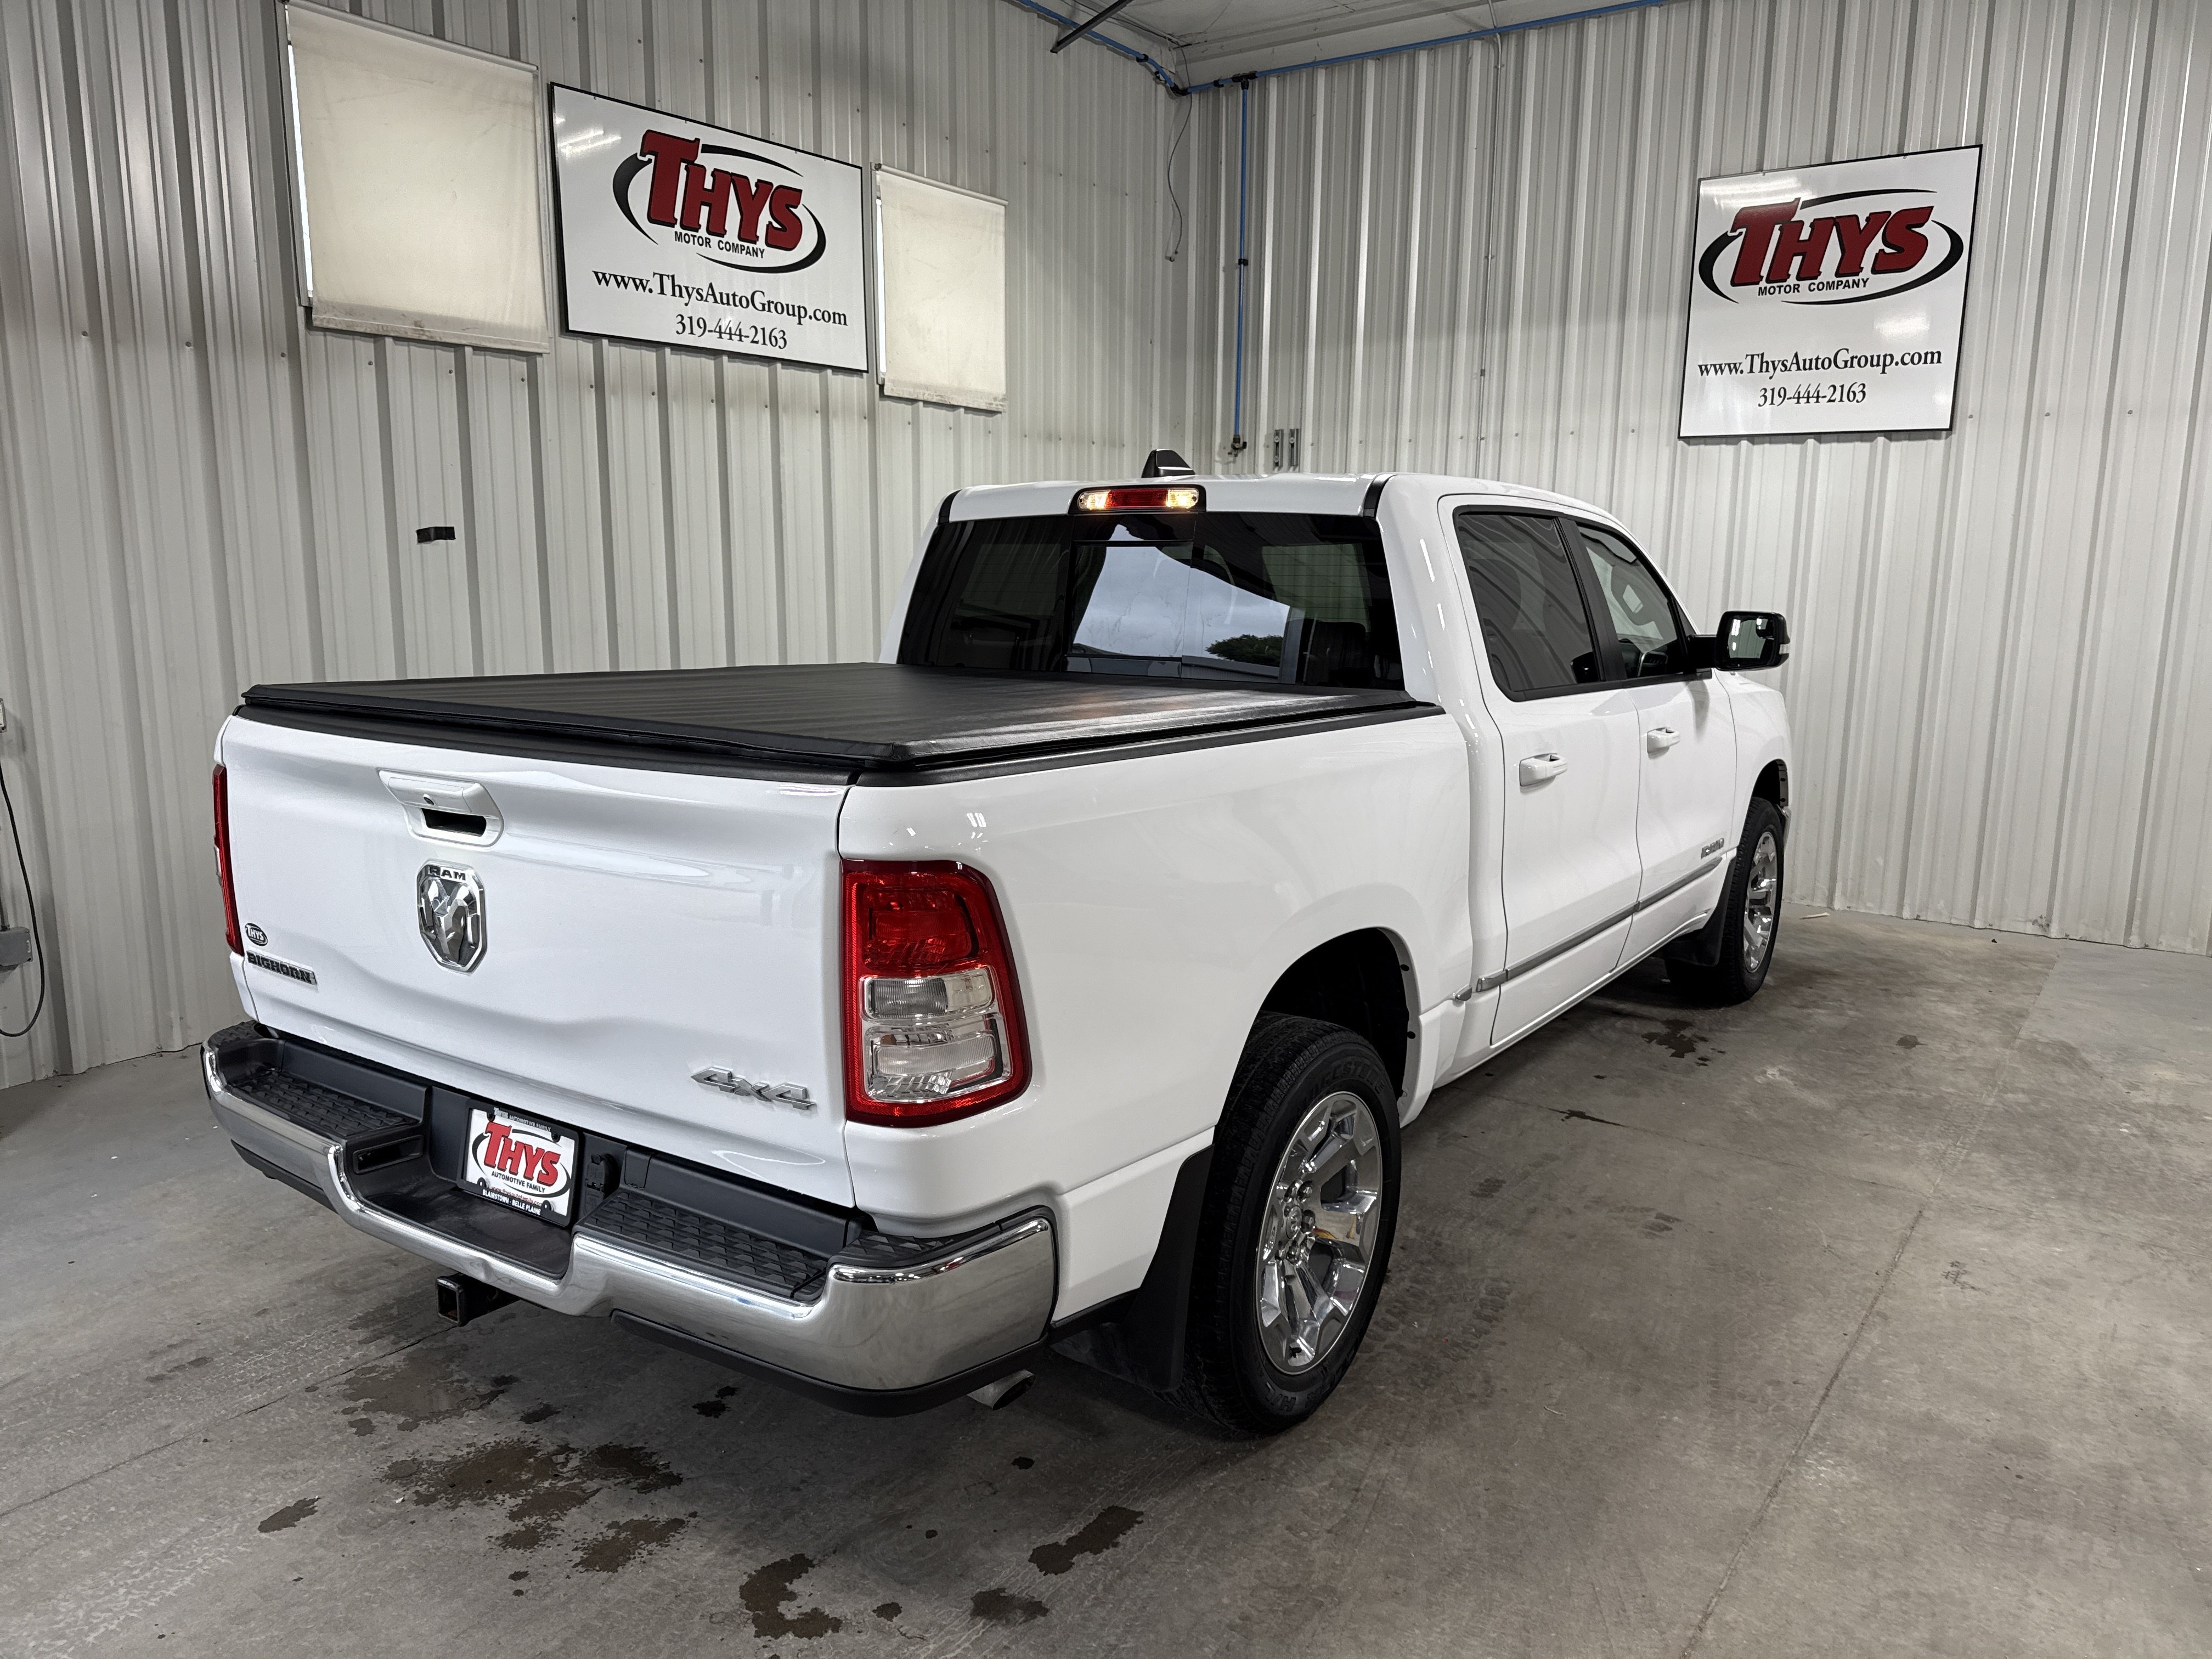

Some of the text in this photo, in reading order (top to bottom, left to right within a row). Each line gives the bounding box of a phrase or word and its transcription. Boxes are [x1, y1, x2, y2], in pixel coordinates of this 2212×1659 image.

[640, 129, 803, 251] THYS
[674, 230, 765, 259] MOTOR COMPANY
[1730, 198, 1934, 286] THYS
[592, 270, 848, 326] www.ThysAutoGroup.com
[1757, 278, 1870, 296] MOTOR COMPANY
[675, 314, 787, 349] 319-444-2163
[1698, 348, 1942, 380] www.ThysAutoGroup.com
[1758, 382, 1866, 407] 319-444-2163
[428, 867, 466, 881] RAM
[246, 924, 264, 941] THYS
[509, 1115, 536, 1127] AUTOMOTIVE
[536, 1123, 551, 1132] FAMILY
[484, 1121, 561, 1187] THYS
[492, 1171, 546, 1193] AUTOMOTIVE FAMILY
[482, 1189, 541, 1216] BLAIRSTOWN BELLE PLAINE
